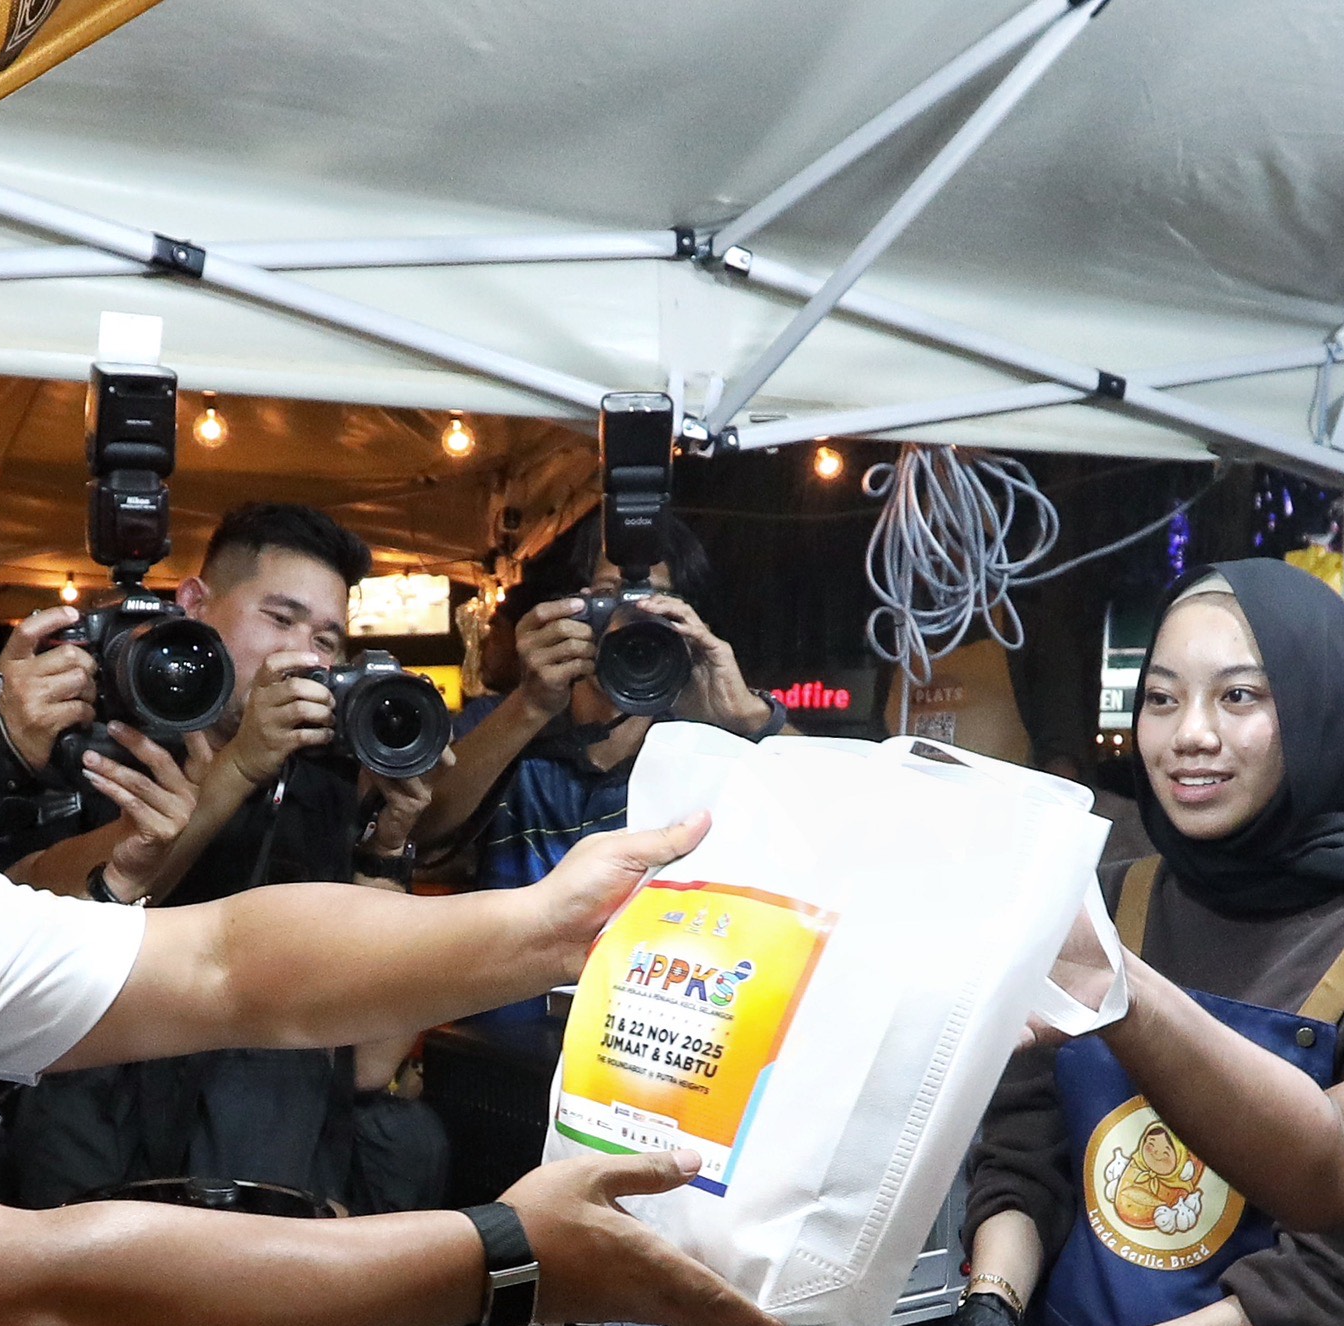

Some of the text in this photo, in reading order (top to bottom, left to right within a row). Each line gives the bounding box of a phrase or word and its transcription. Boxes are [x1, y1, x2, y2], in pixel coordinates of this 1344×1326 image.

[127, 600, 160, 610] Nikon
[367, 663, 395, 671] Canon
[604, 1014, 724, 1059] 21 & 22 NOV 2025
[601, 1033, 718, 1078] JUMAAT & SABTU
[1120, 1244, 1165, 1268] Garlic
[1170, 1244, 1210, 1268] Bread
